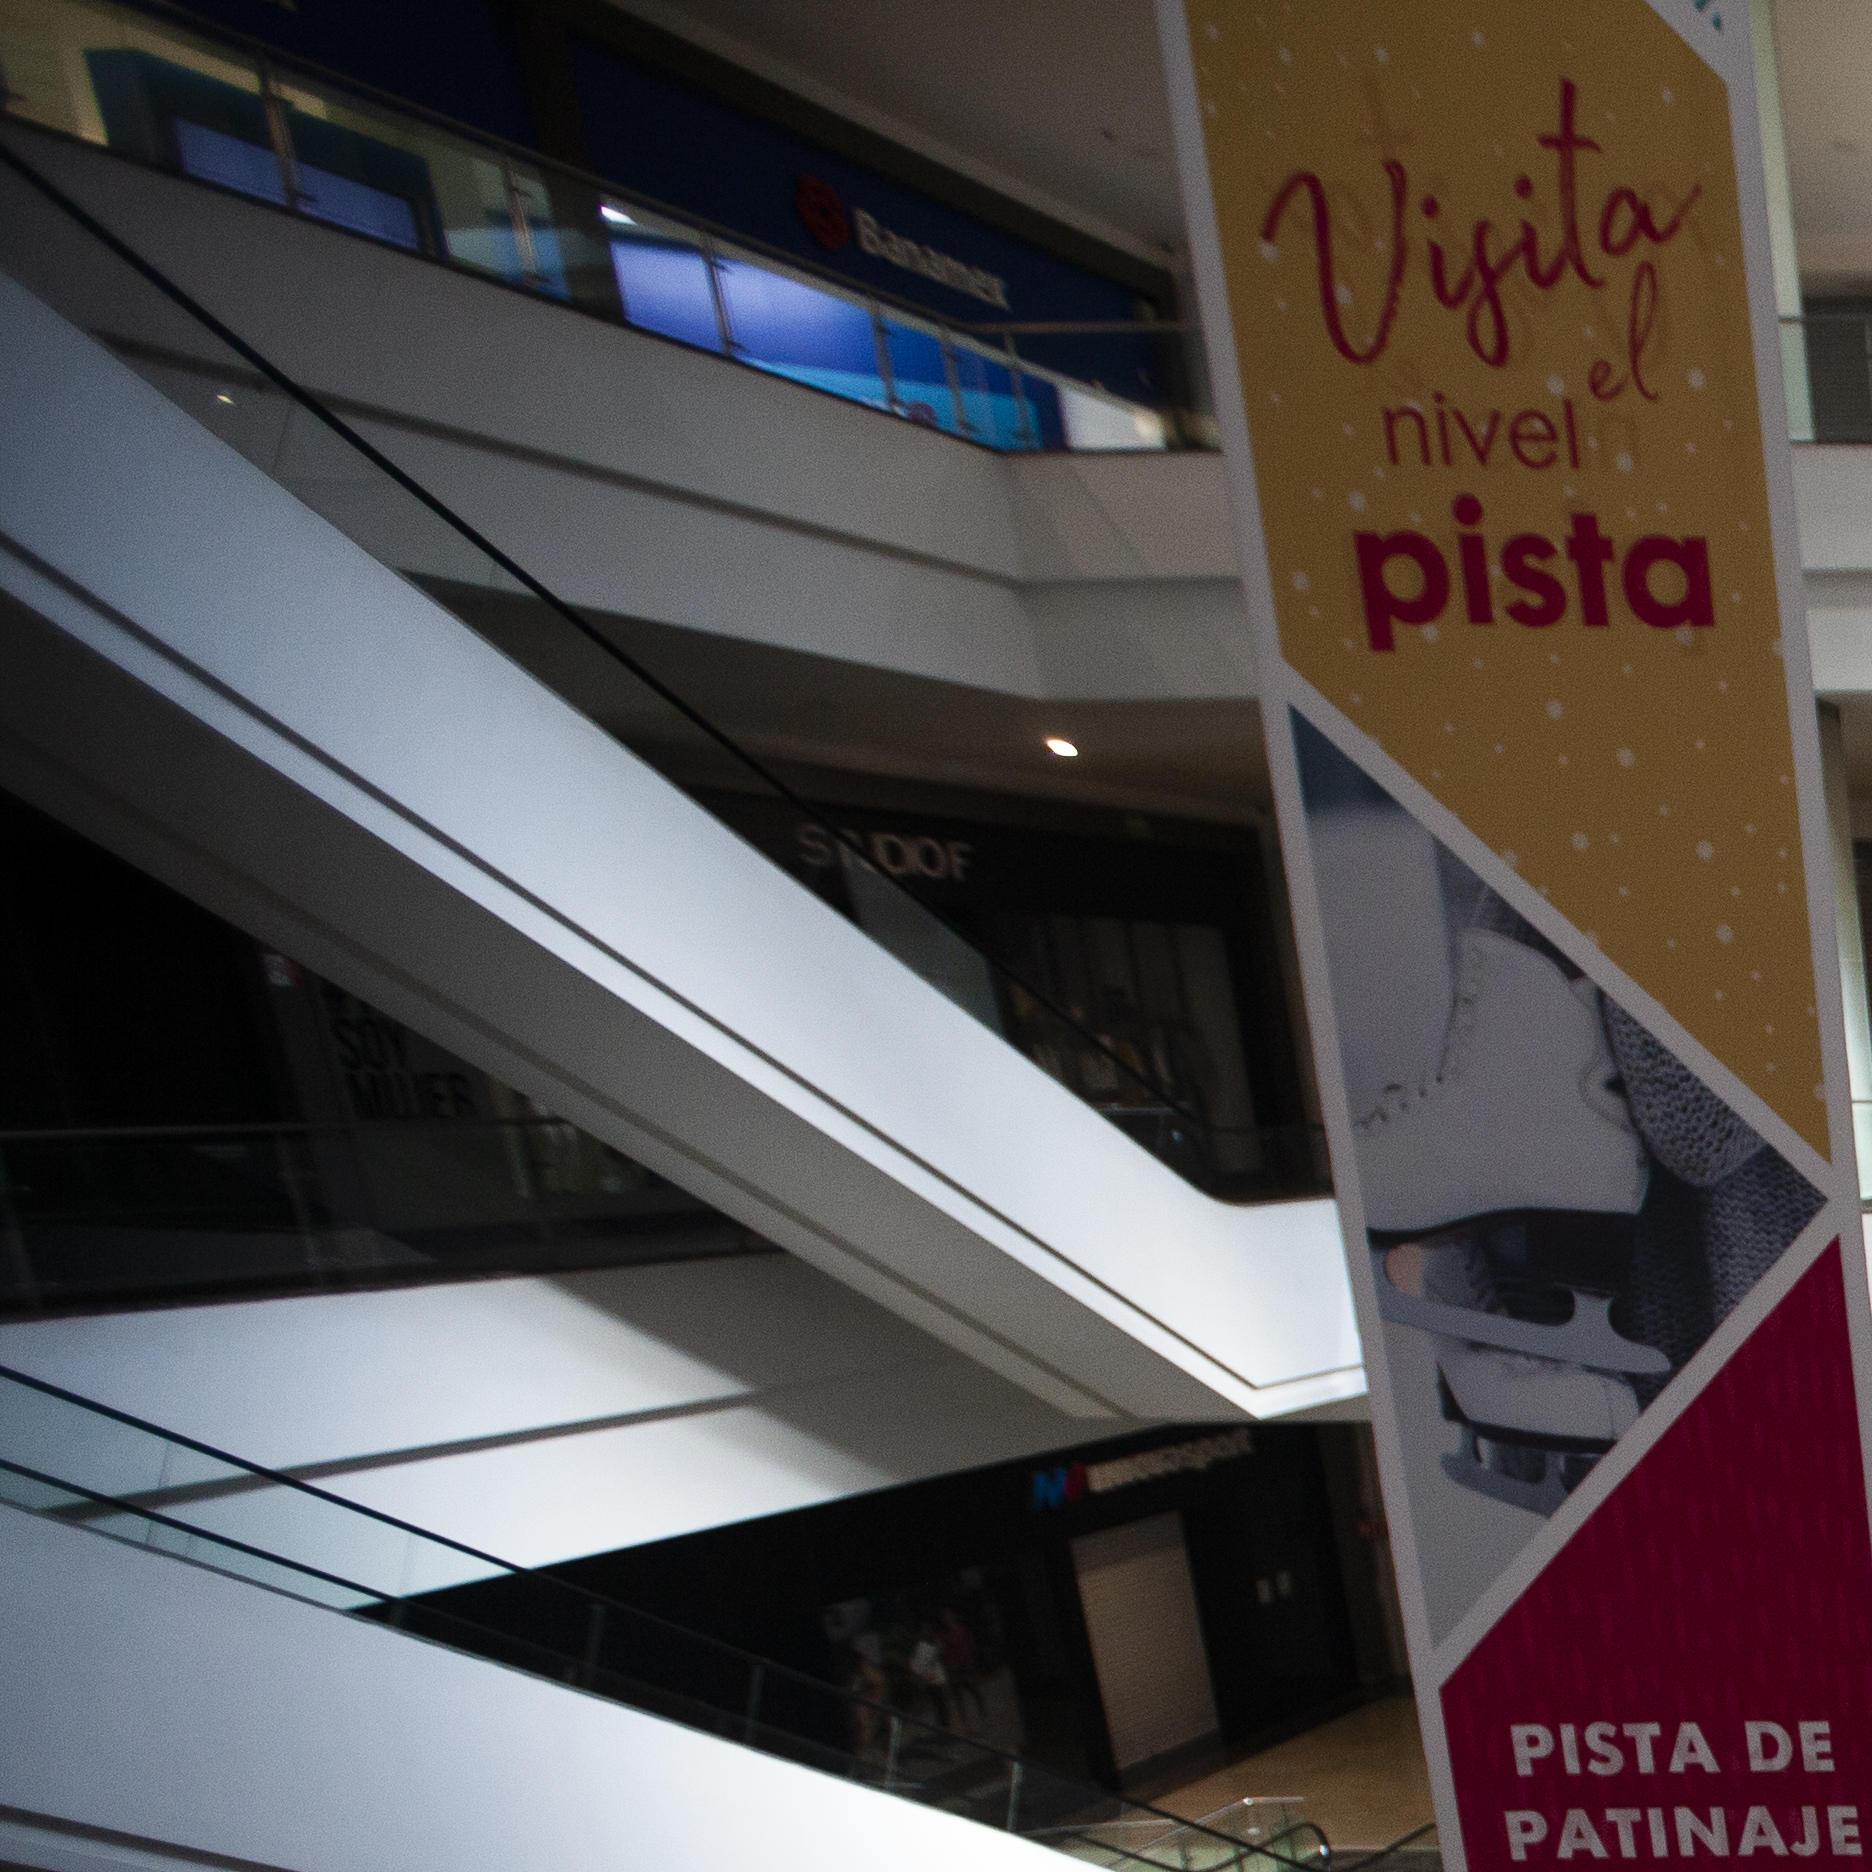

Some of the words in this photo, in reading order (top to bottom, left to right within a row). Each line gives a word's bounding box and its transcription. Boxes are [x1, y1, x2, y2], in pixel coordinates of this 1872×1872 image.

[1263, 79, 1701, 366] Visita
[1588, 262, 1659, 401] el
[1383, 393, 1581, 470] nivel
[1354, 494, 1714, 651] pista
[1510, 1720, 1721, 1778] PISTA
[1744, 1719, 1836, 1775] DE
[1503, 1804, 1864, 1862] PATINAJE
